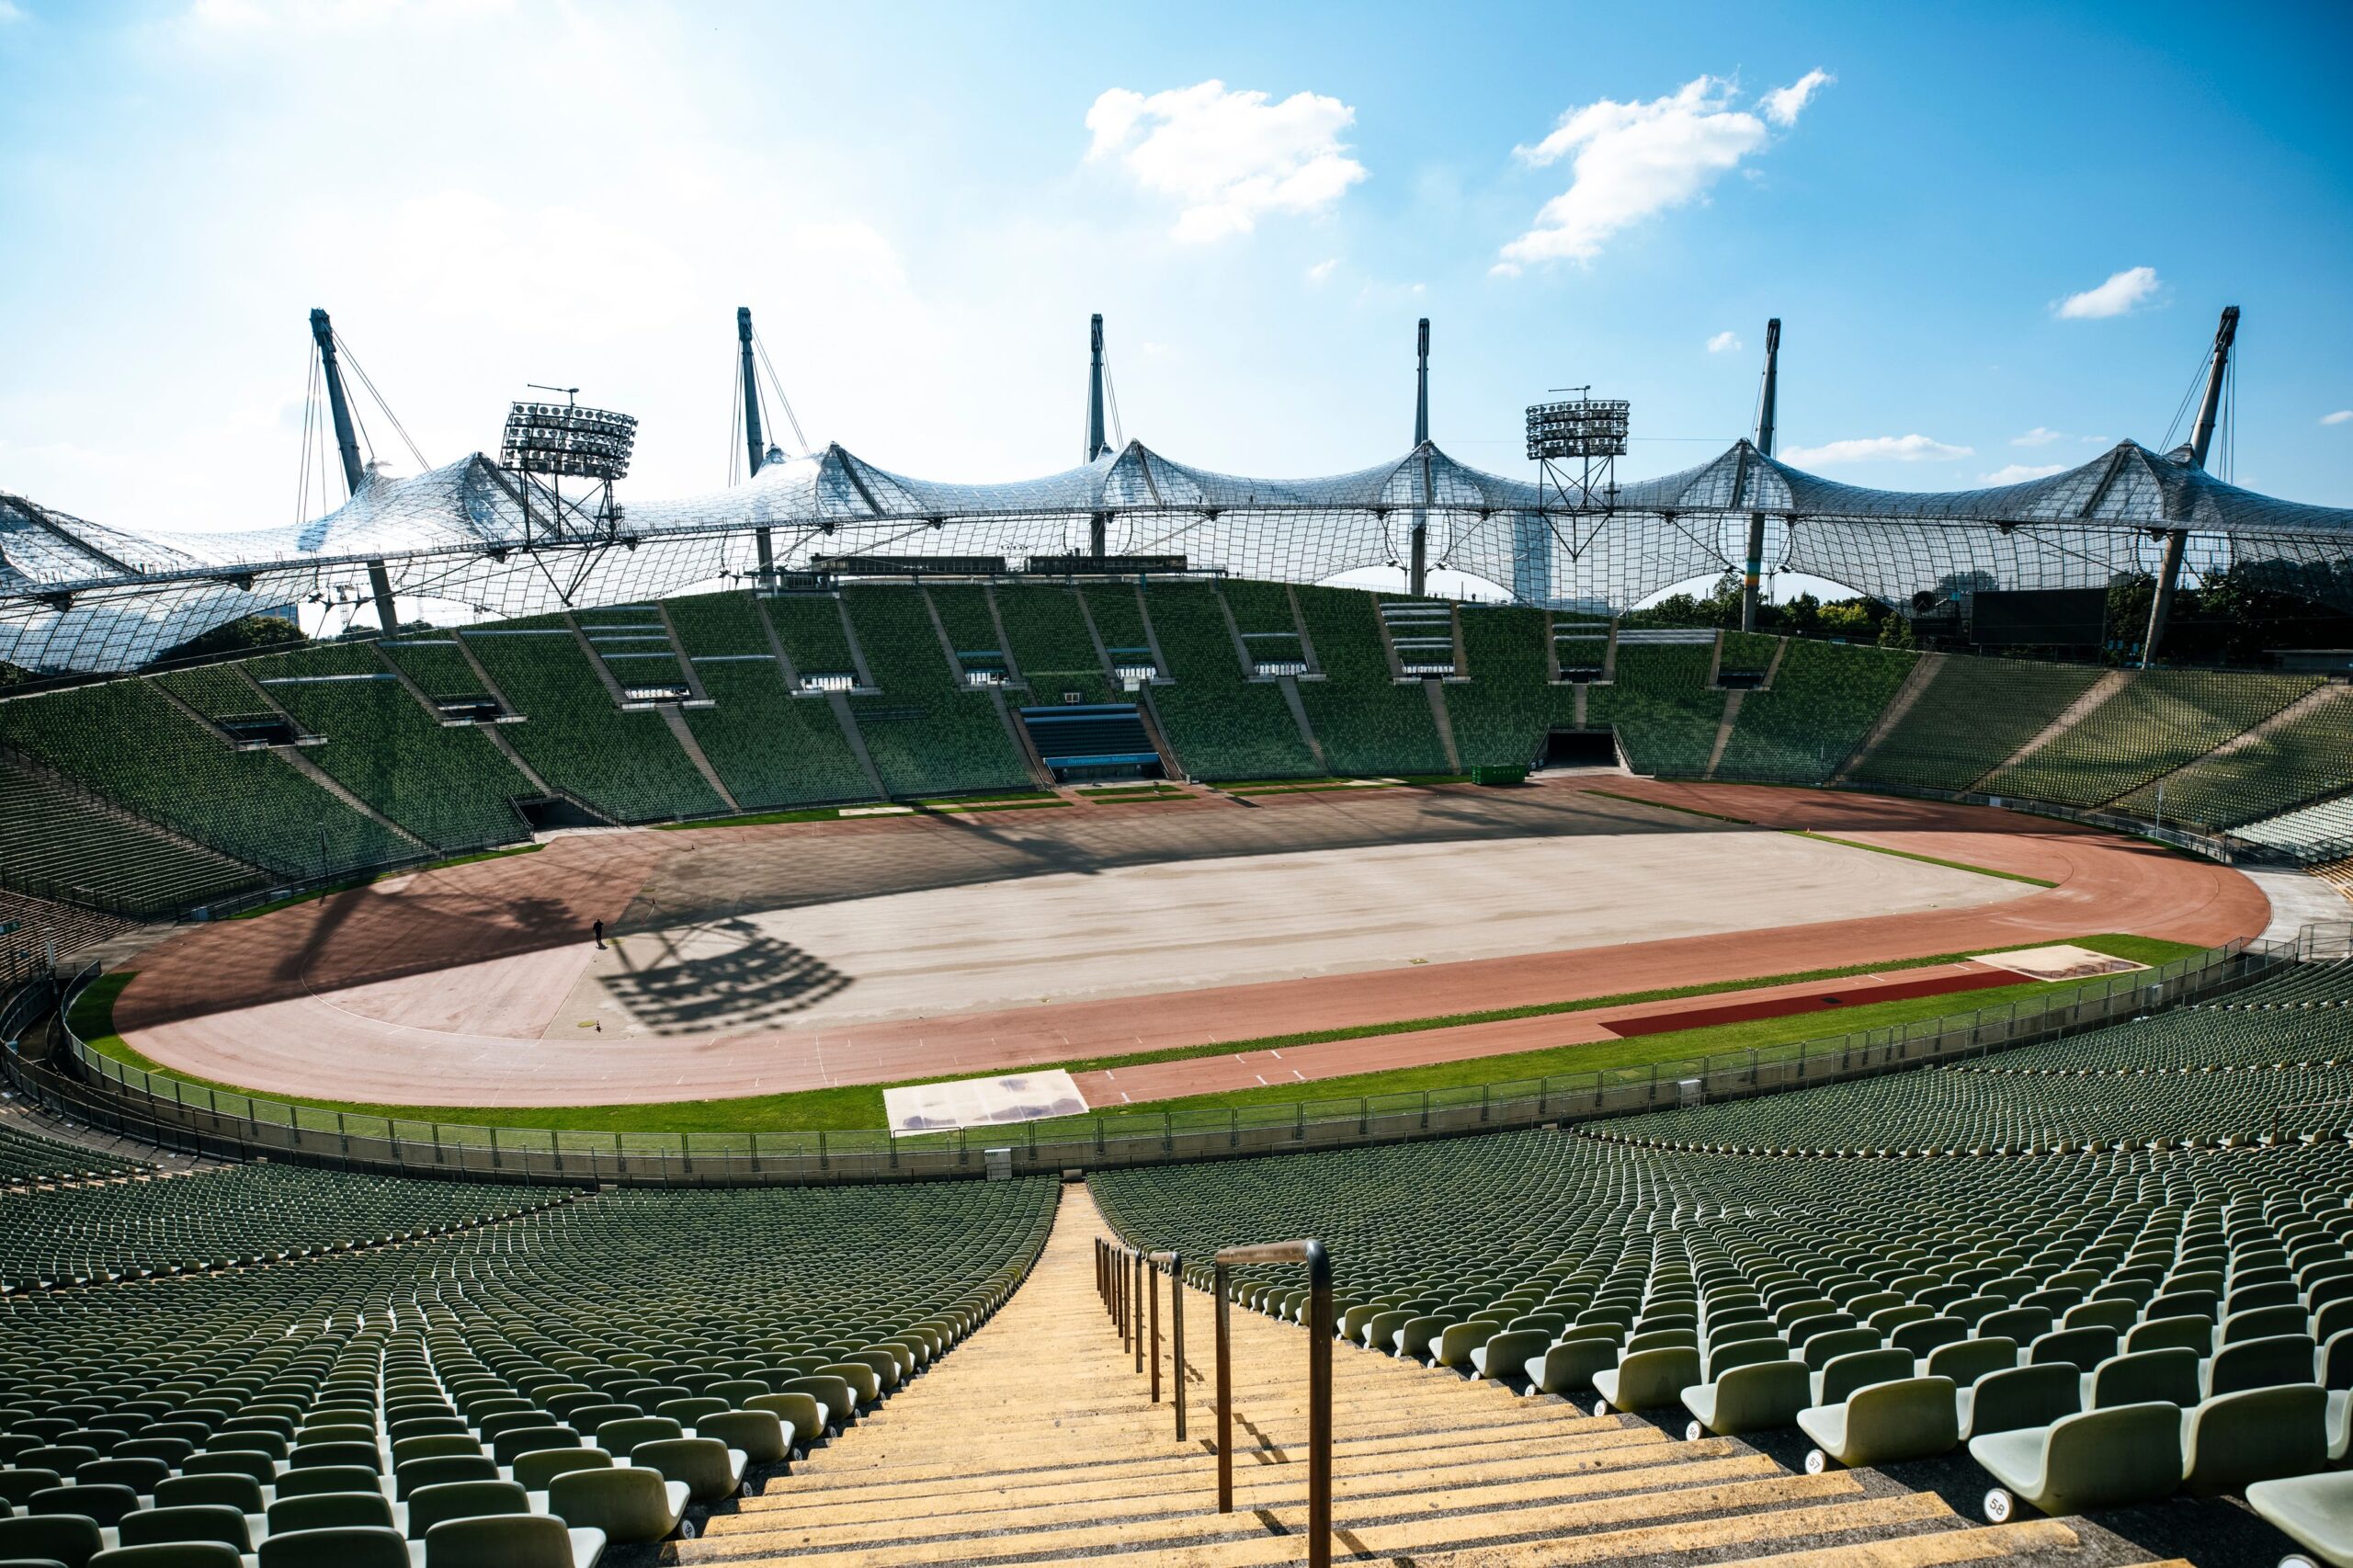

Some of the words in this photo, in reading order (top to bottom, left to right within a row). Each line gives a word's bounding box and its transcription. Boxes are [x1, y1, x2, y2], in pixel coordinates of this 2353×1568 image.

[1688, 1426, 1698, 1438] 56
[1809, 1457, 1820, 1470] 57
[1989, 1498, 2006, 1516] 58
